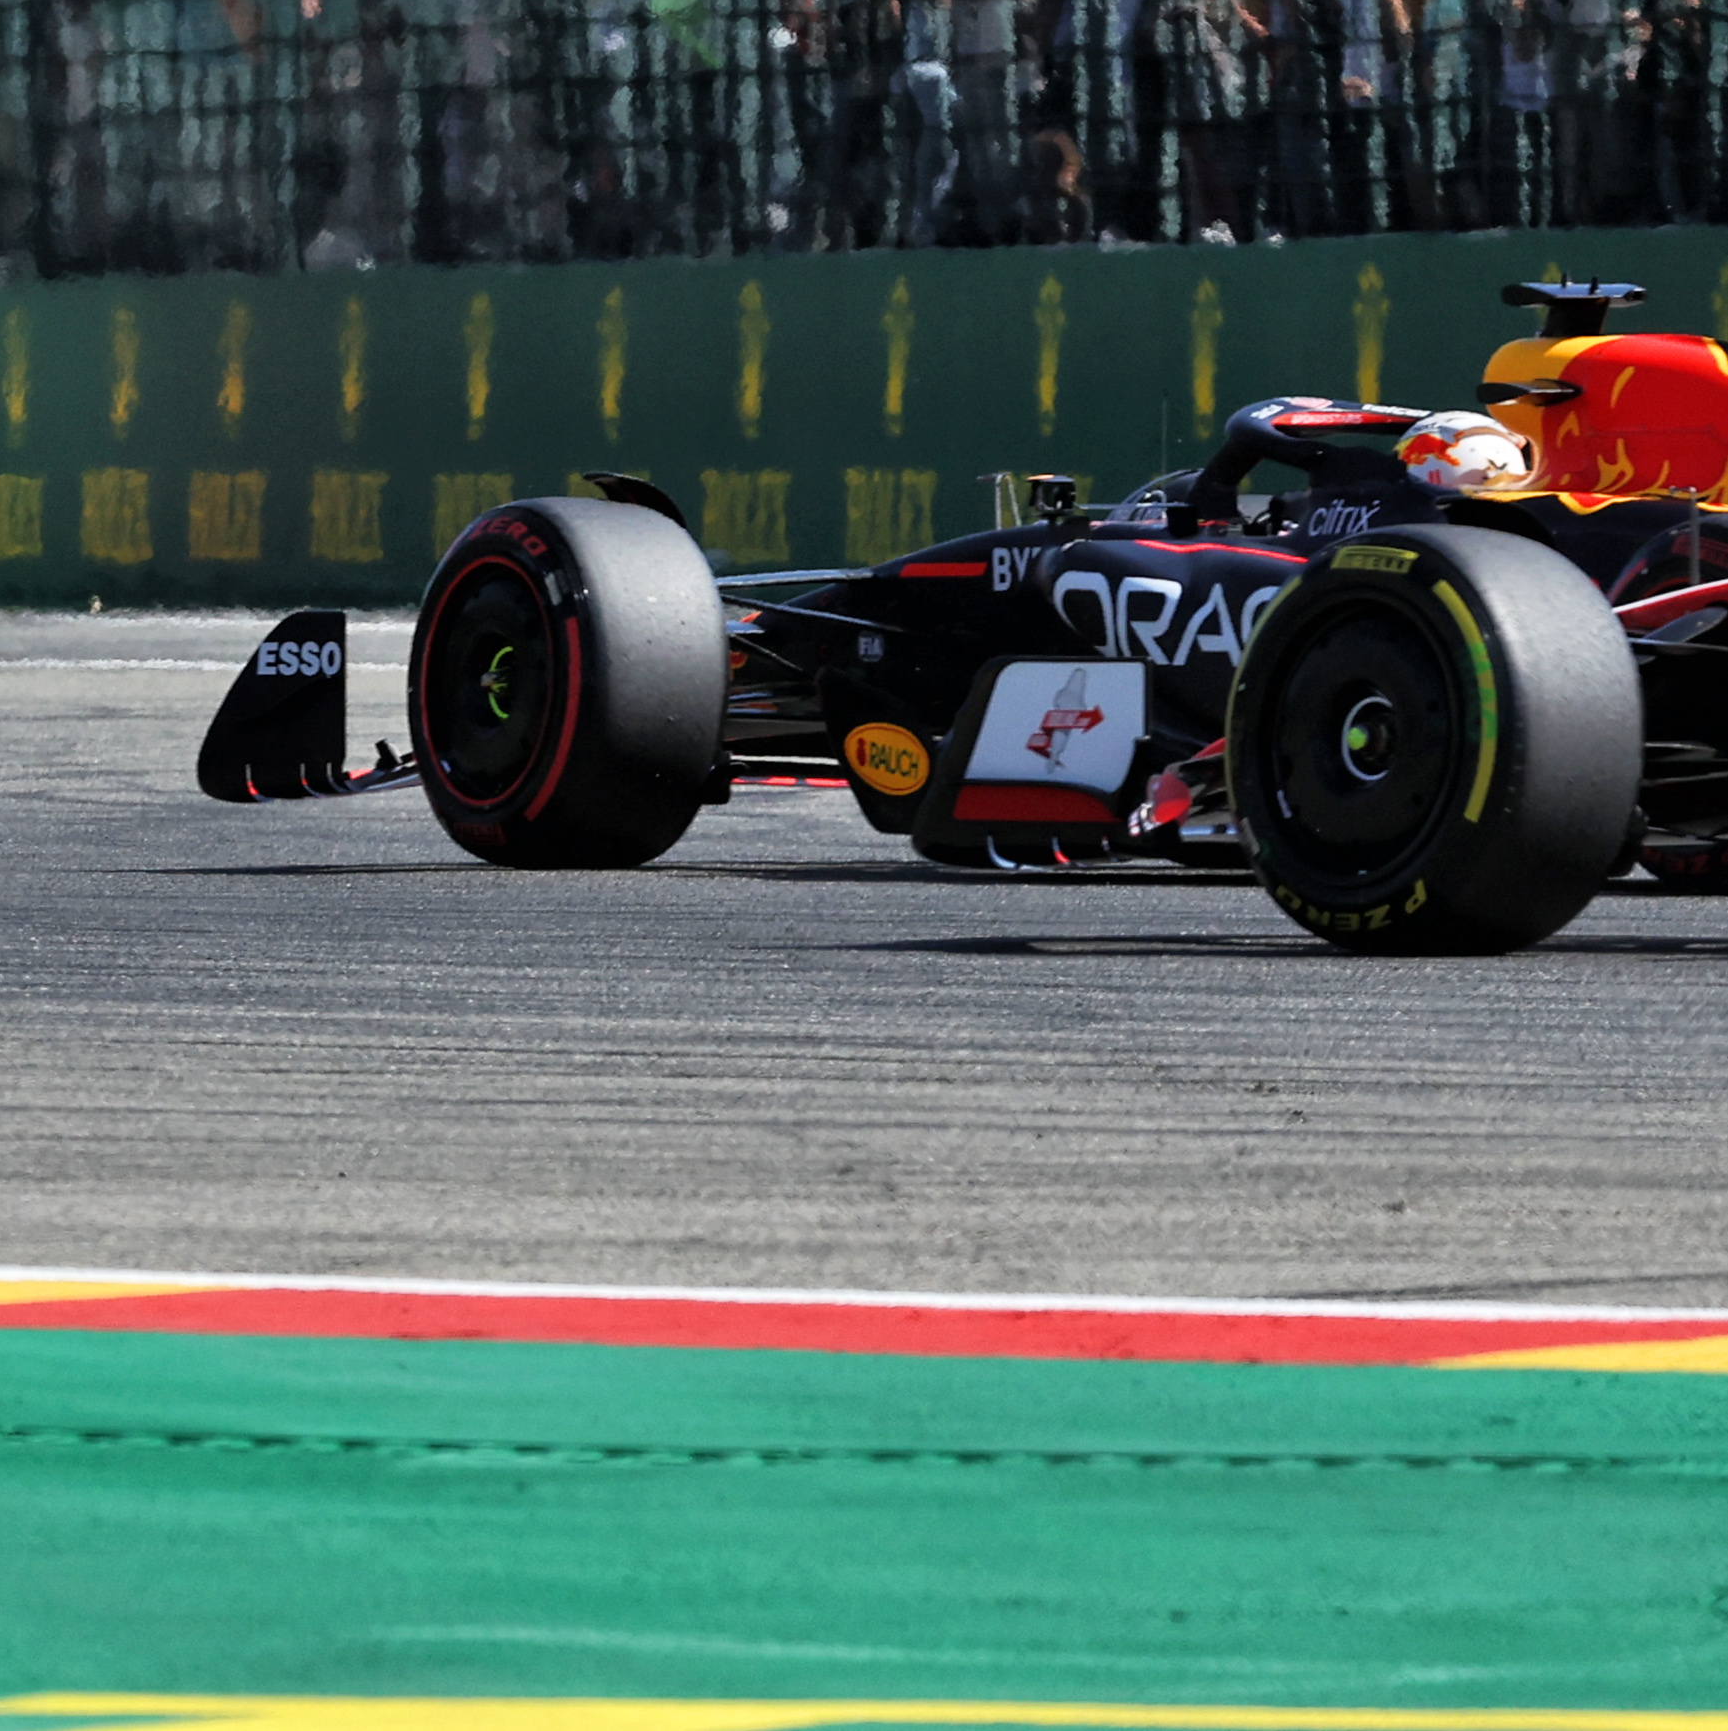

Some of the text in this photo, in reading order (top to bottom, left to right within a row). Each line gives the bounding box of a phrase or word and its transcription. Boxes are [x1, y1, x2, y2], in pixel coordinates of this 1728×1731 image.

[1308, 499, 1381, 537] citrix
[256, 641, 342, 677] ESSO
[869, 741, 918, 779] RAUCH
[1275, 884, 1391, 932] ZERO
